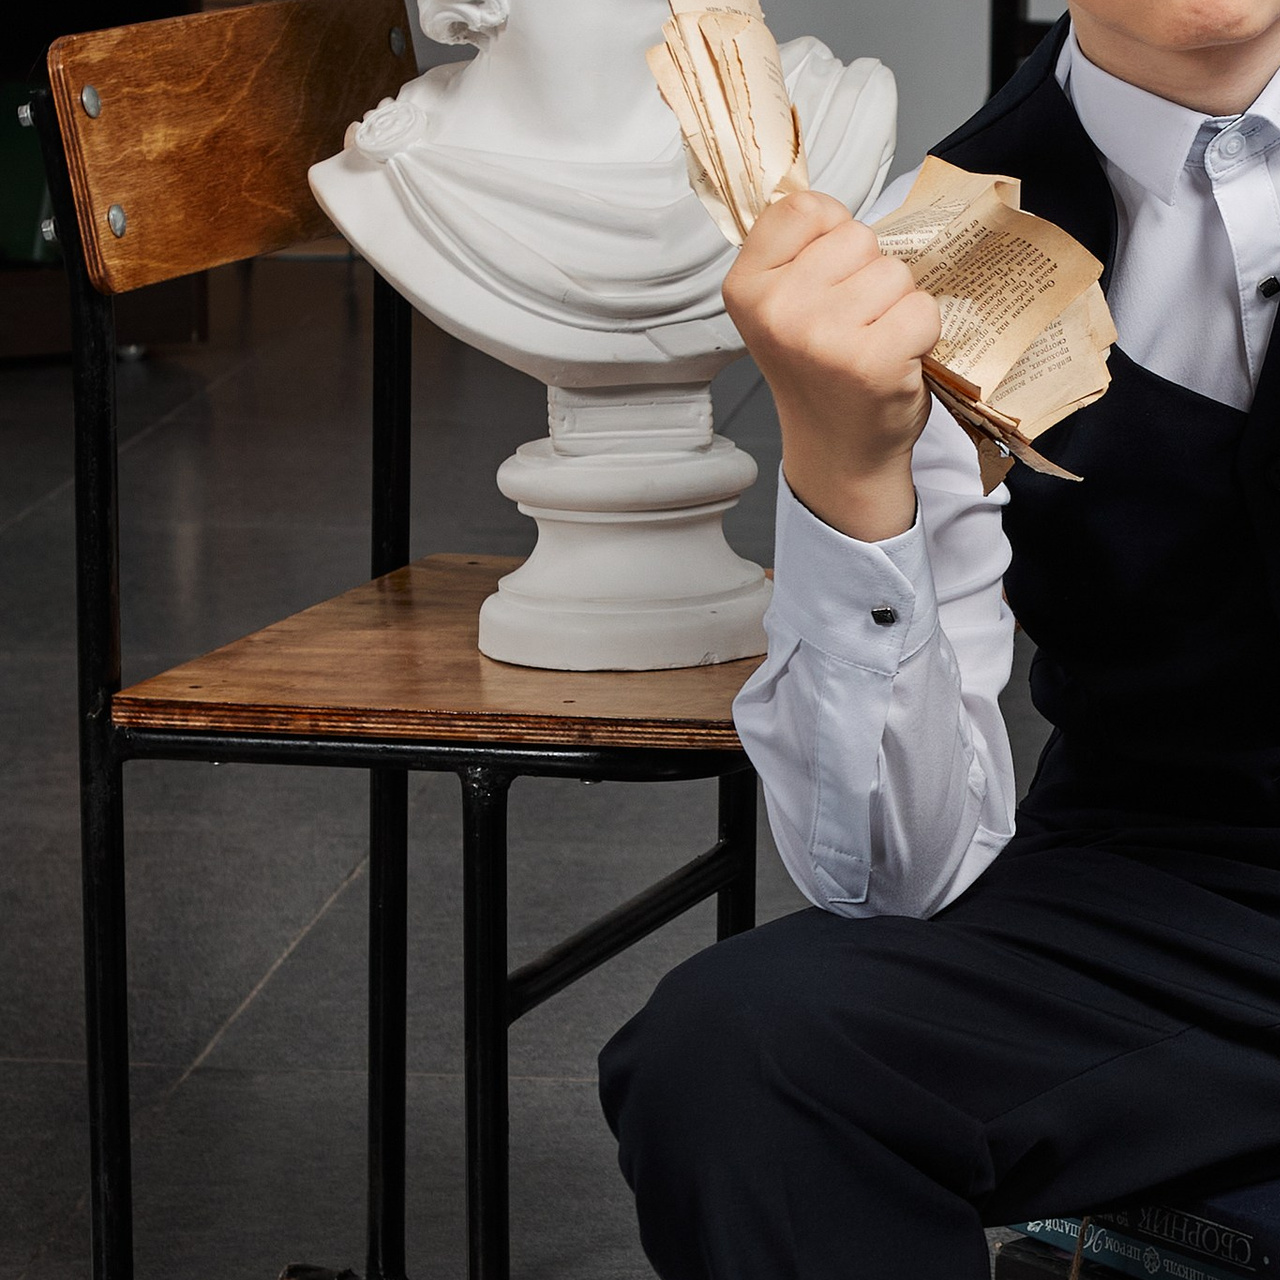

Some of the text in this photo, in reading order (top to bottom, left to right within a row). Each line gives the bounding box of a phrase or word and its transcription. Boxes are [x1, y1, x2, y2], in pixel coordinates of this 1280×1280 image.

[1010, 294, 1036, 319] летели
[994, 319, 1010, 336] над
[961, 328, 989, 359] прячась
[1134, 1203, 1255, 1264] СБОРНИК
[1102, 1235, 1142, 1260] ПЕРОМ
